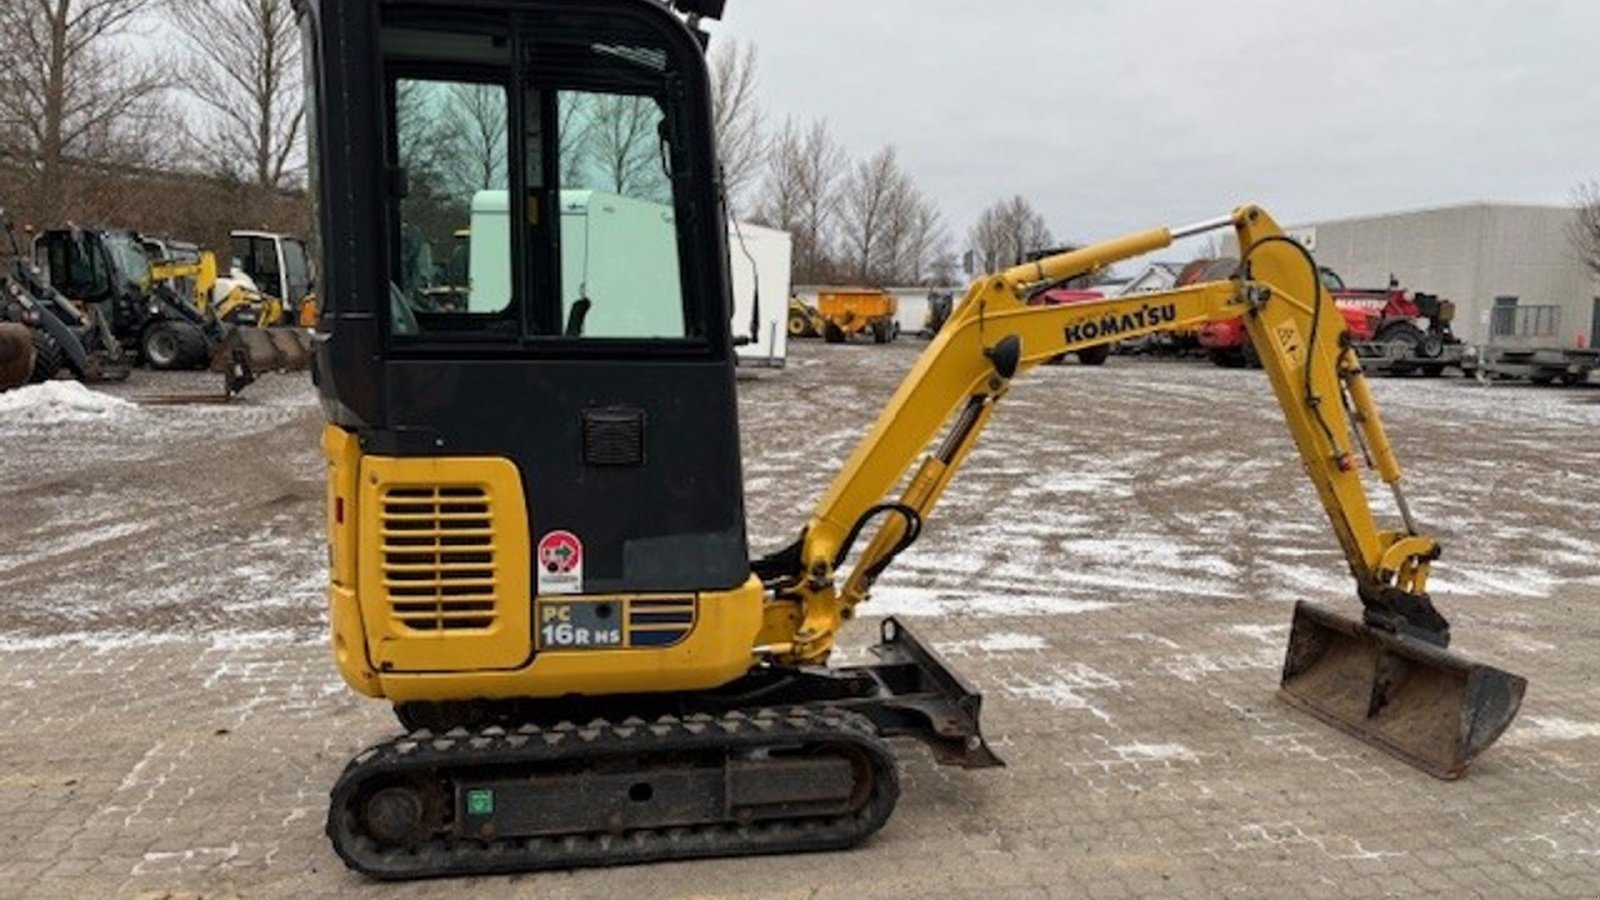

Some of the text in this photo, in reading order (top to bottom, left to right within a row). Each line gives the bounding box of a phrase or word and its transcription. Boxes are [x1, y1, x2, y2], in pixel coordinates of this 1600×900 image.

[1064, 303, 1177, 343] KOMATSU
[543, 606, 571, 622] PC
[542, 623, 620, 645] 16R HS
